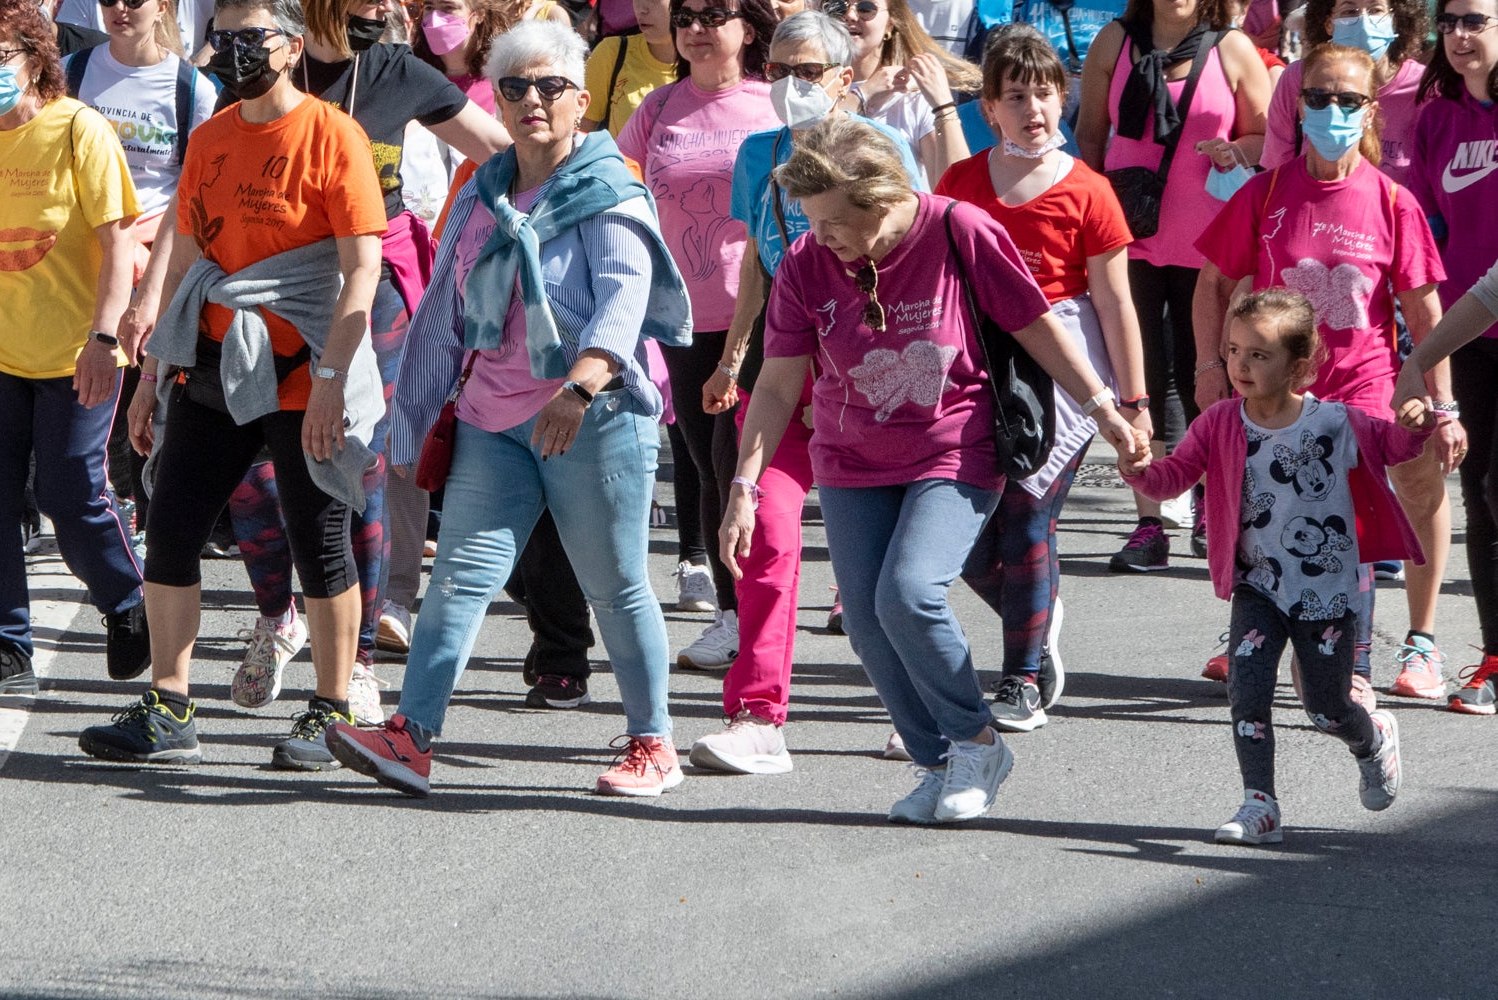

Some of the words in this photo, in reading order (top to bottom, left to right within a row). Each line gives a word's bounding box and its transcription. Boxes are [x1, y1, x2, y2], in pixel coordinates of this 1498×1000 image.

[140, 112, 152, 122] DE
[5, 168, 40, 179] Marcha
[261, 155, 289, 179] 10
[10, 178, 48, 190] Mujeres
[233, 183, 275, 199] Marcha
[238, 198, 287, 214] Mujeres
[265, 217, 286, 231] 2017
[1327, 223, 1365, 239] Marcha
[1332, 235, 1374, 251] Mujeres
[887, 300, 931, 317] Marcha
[932, 295, 942, 305] de
[895, 307, 944, 325] Mujeres
